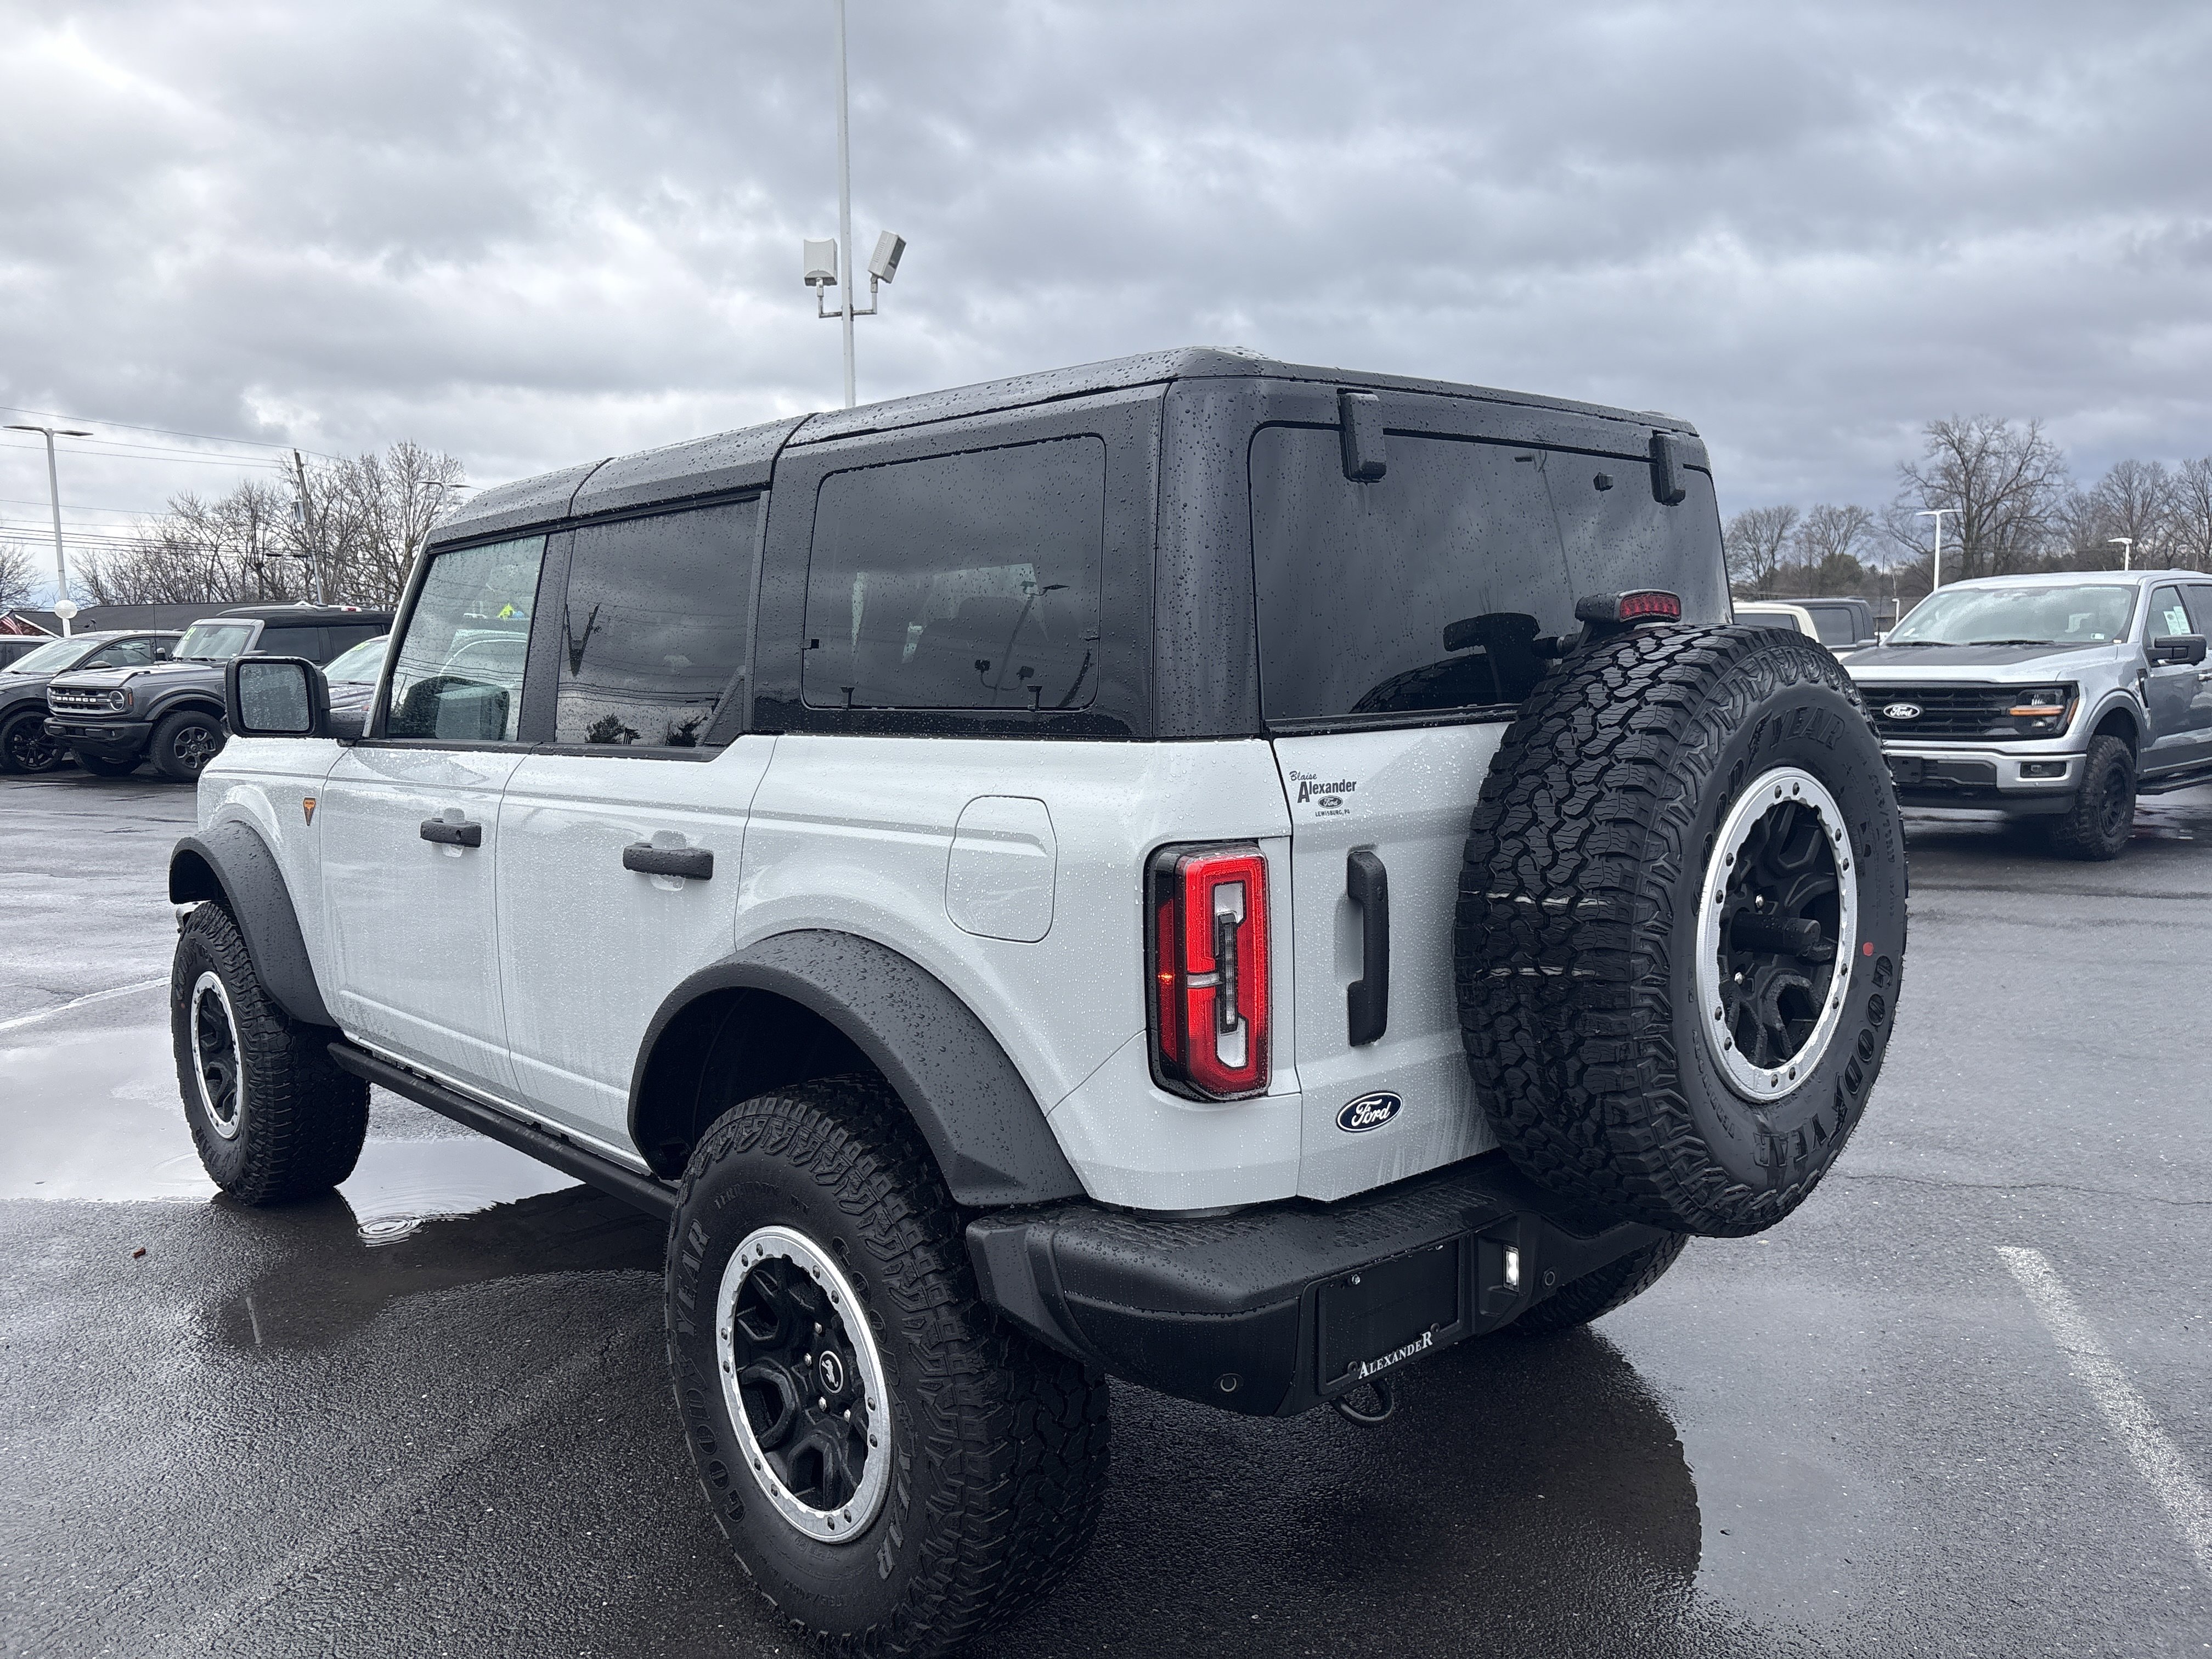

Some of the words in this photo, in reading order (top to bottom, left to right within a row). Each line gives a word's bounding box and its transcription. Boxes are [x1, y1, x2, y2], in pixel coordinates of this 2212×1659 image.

[1289, 771, 1317, 781] Blaise
[1297, 779, 1357, 803] Alexander
[1358, 1330, 1433, 1380] ALEXANDER
